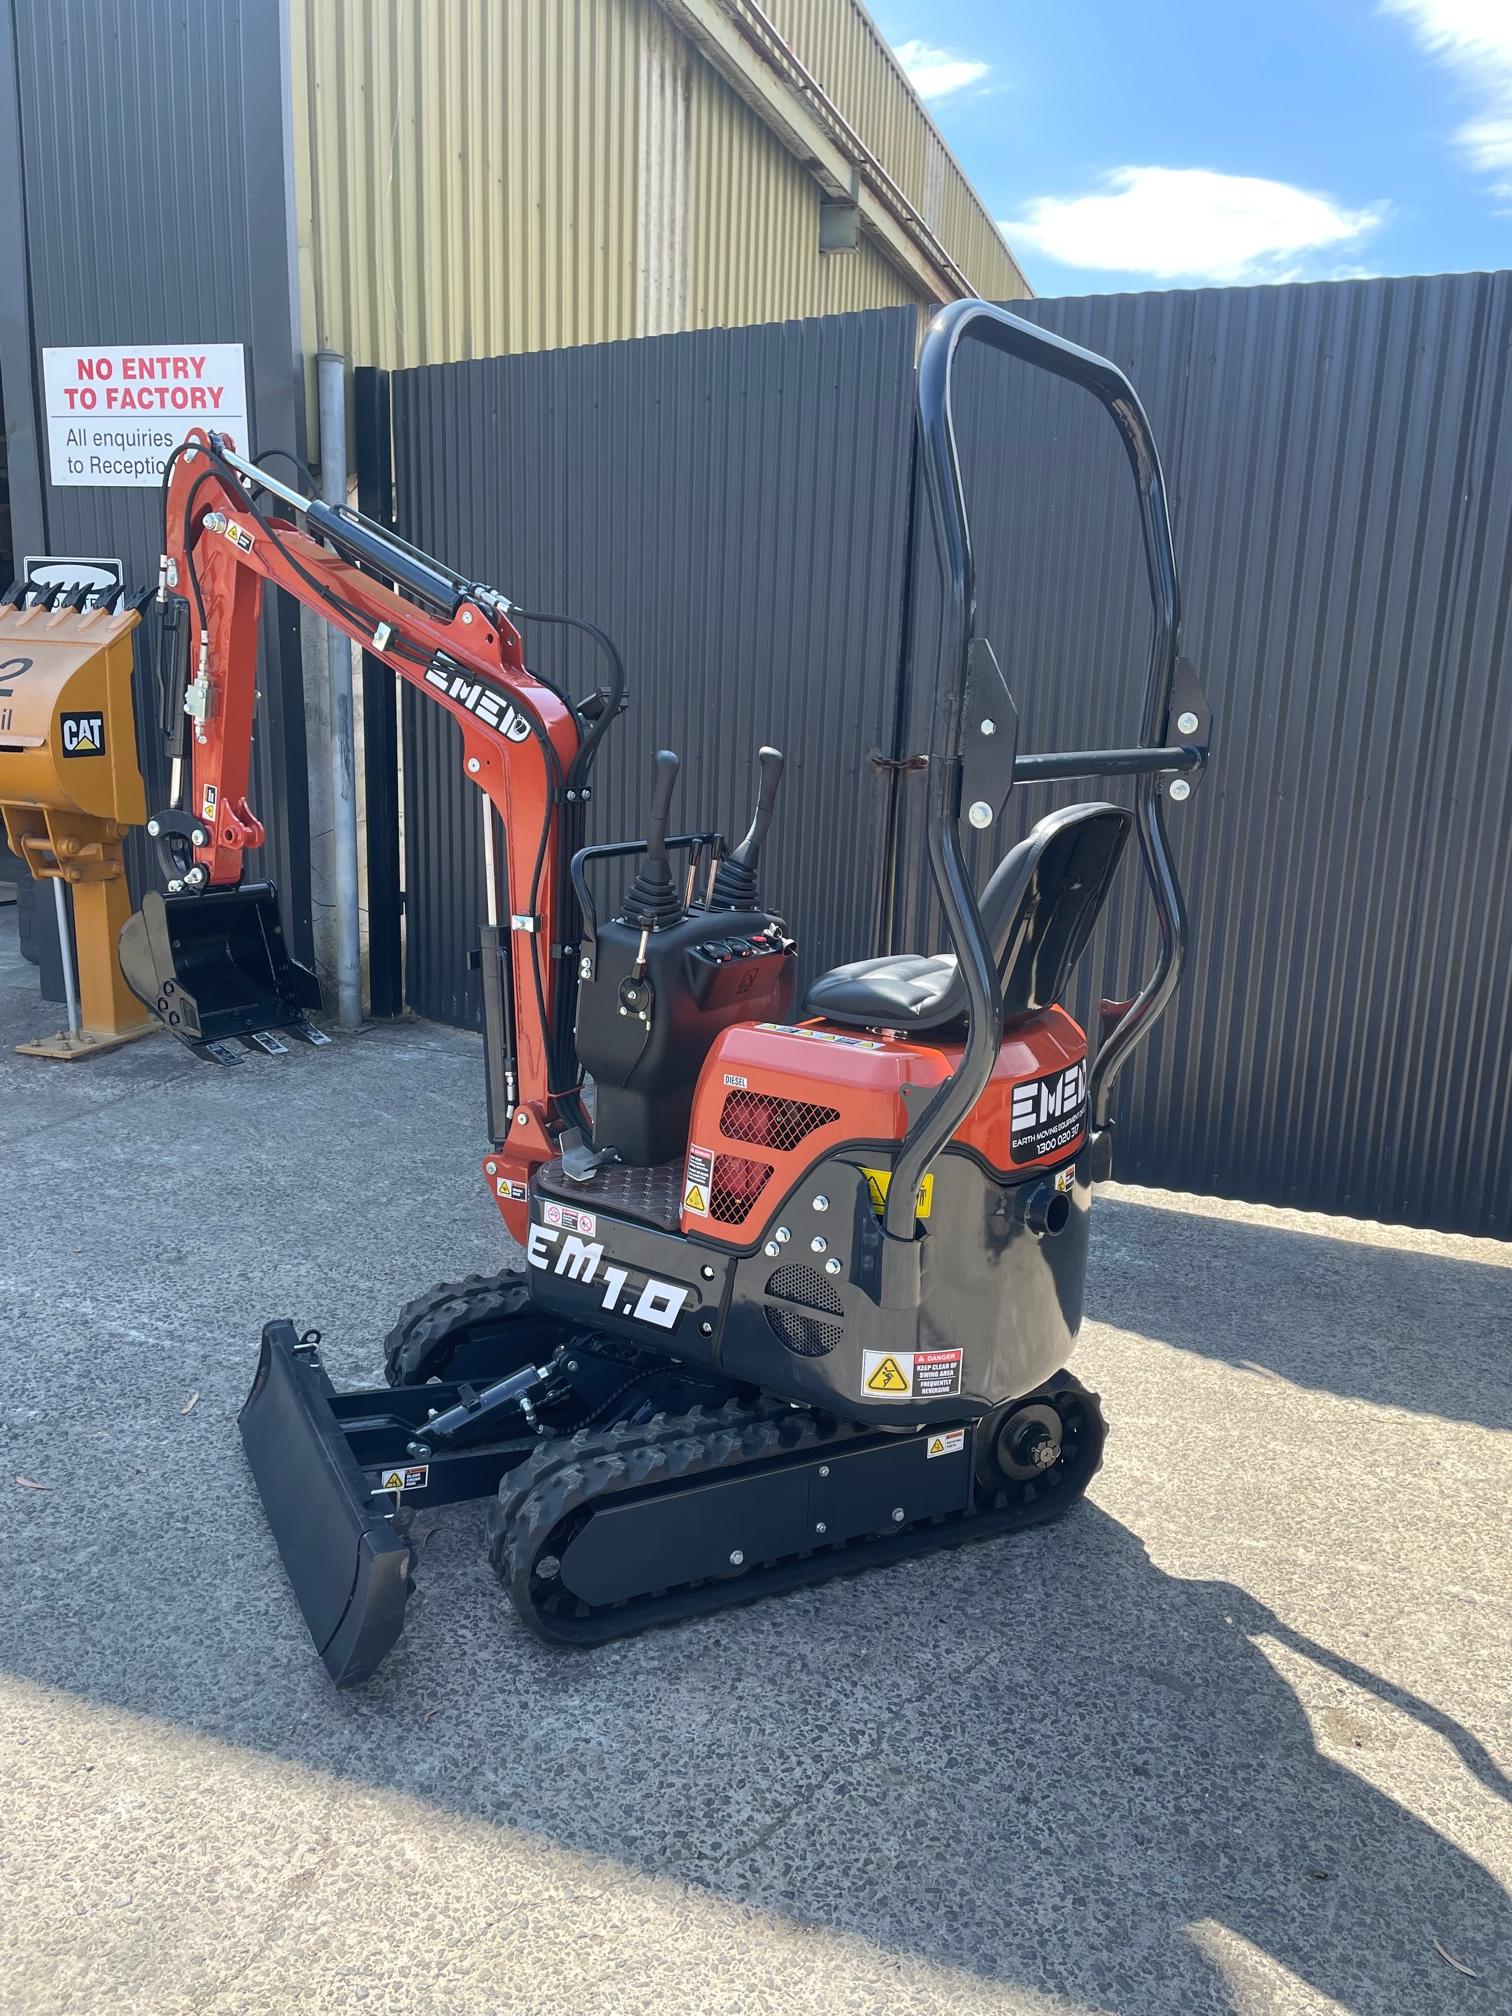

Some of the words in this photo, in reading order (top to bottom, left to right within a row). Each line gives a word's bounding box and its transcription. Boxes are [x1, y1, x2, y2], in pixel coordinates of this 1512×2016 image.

[77, 358, 113, 381] NO
[122, 356, 207, 380] ENTRY
[63, 388, 97, 410] TO
[105, 386, 224, 410] FACTORY
[66, 428, 87, 447] All
[93, 428, 174, 451] enquiries
[67, 458, 84, 474] to
[90, 456, 176, 479] Receptio
[63, 719, 102, 751] CAT
[725, 1075, 746, 1088] DIESEL
[1012, 1133, 1036, 1148] EARTH
[1036, 1124, 1058, 1141] MOVING
[1037, 1138, 1057, 1155] 1300
[1057, 1131, 1071, 1145] 020
[916, 1364, 932, 1372] KEEP
[932, 1363, 950, 1371] CLEAR
[927, 1353, 956, 1362] DANGER
[919, 1371, 939, 1379] SWING
[939, 1369, 954, 1377] AREA
[920, 1379, 952, 1388] FREQUENTLY
[921, 1386, 950, 1395] REVERSING
